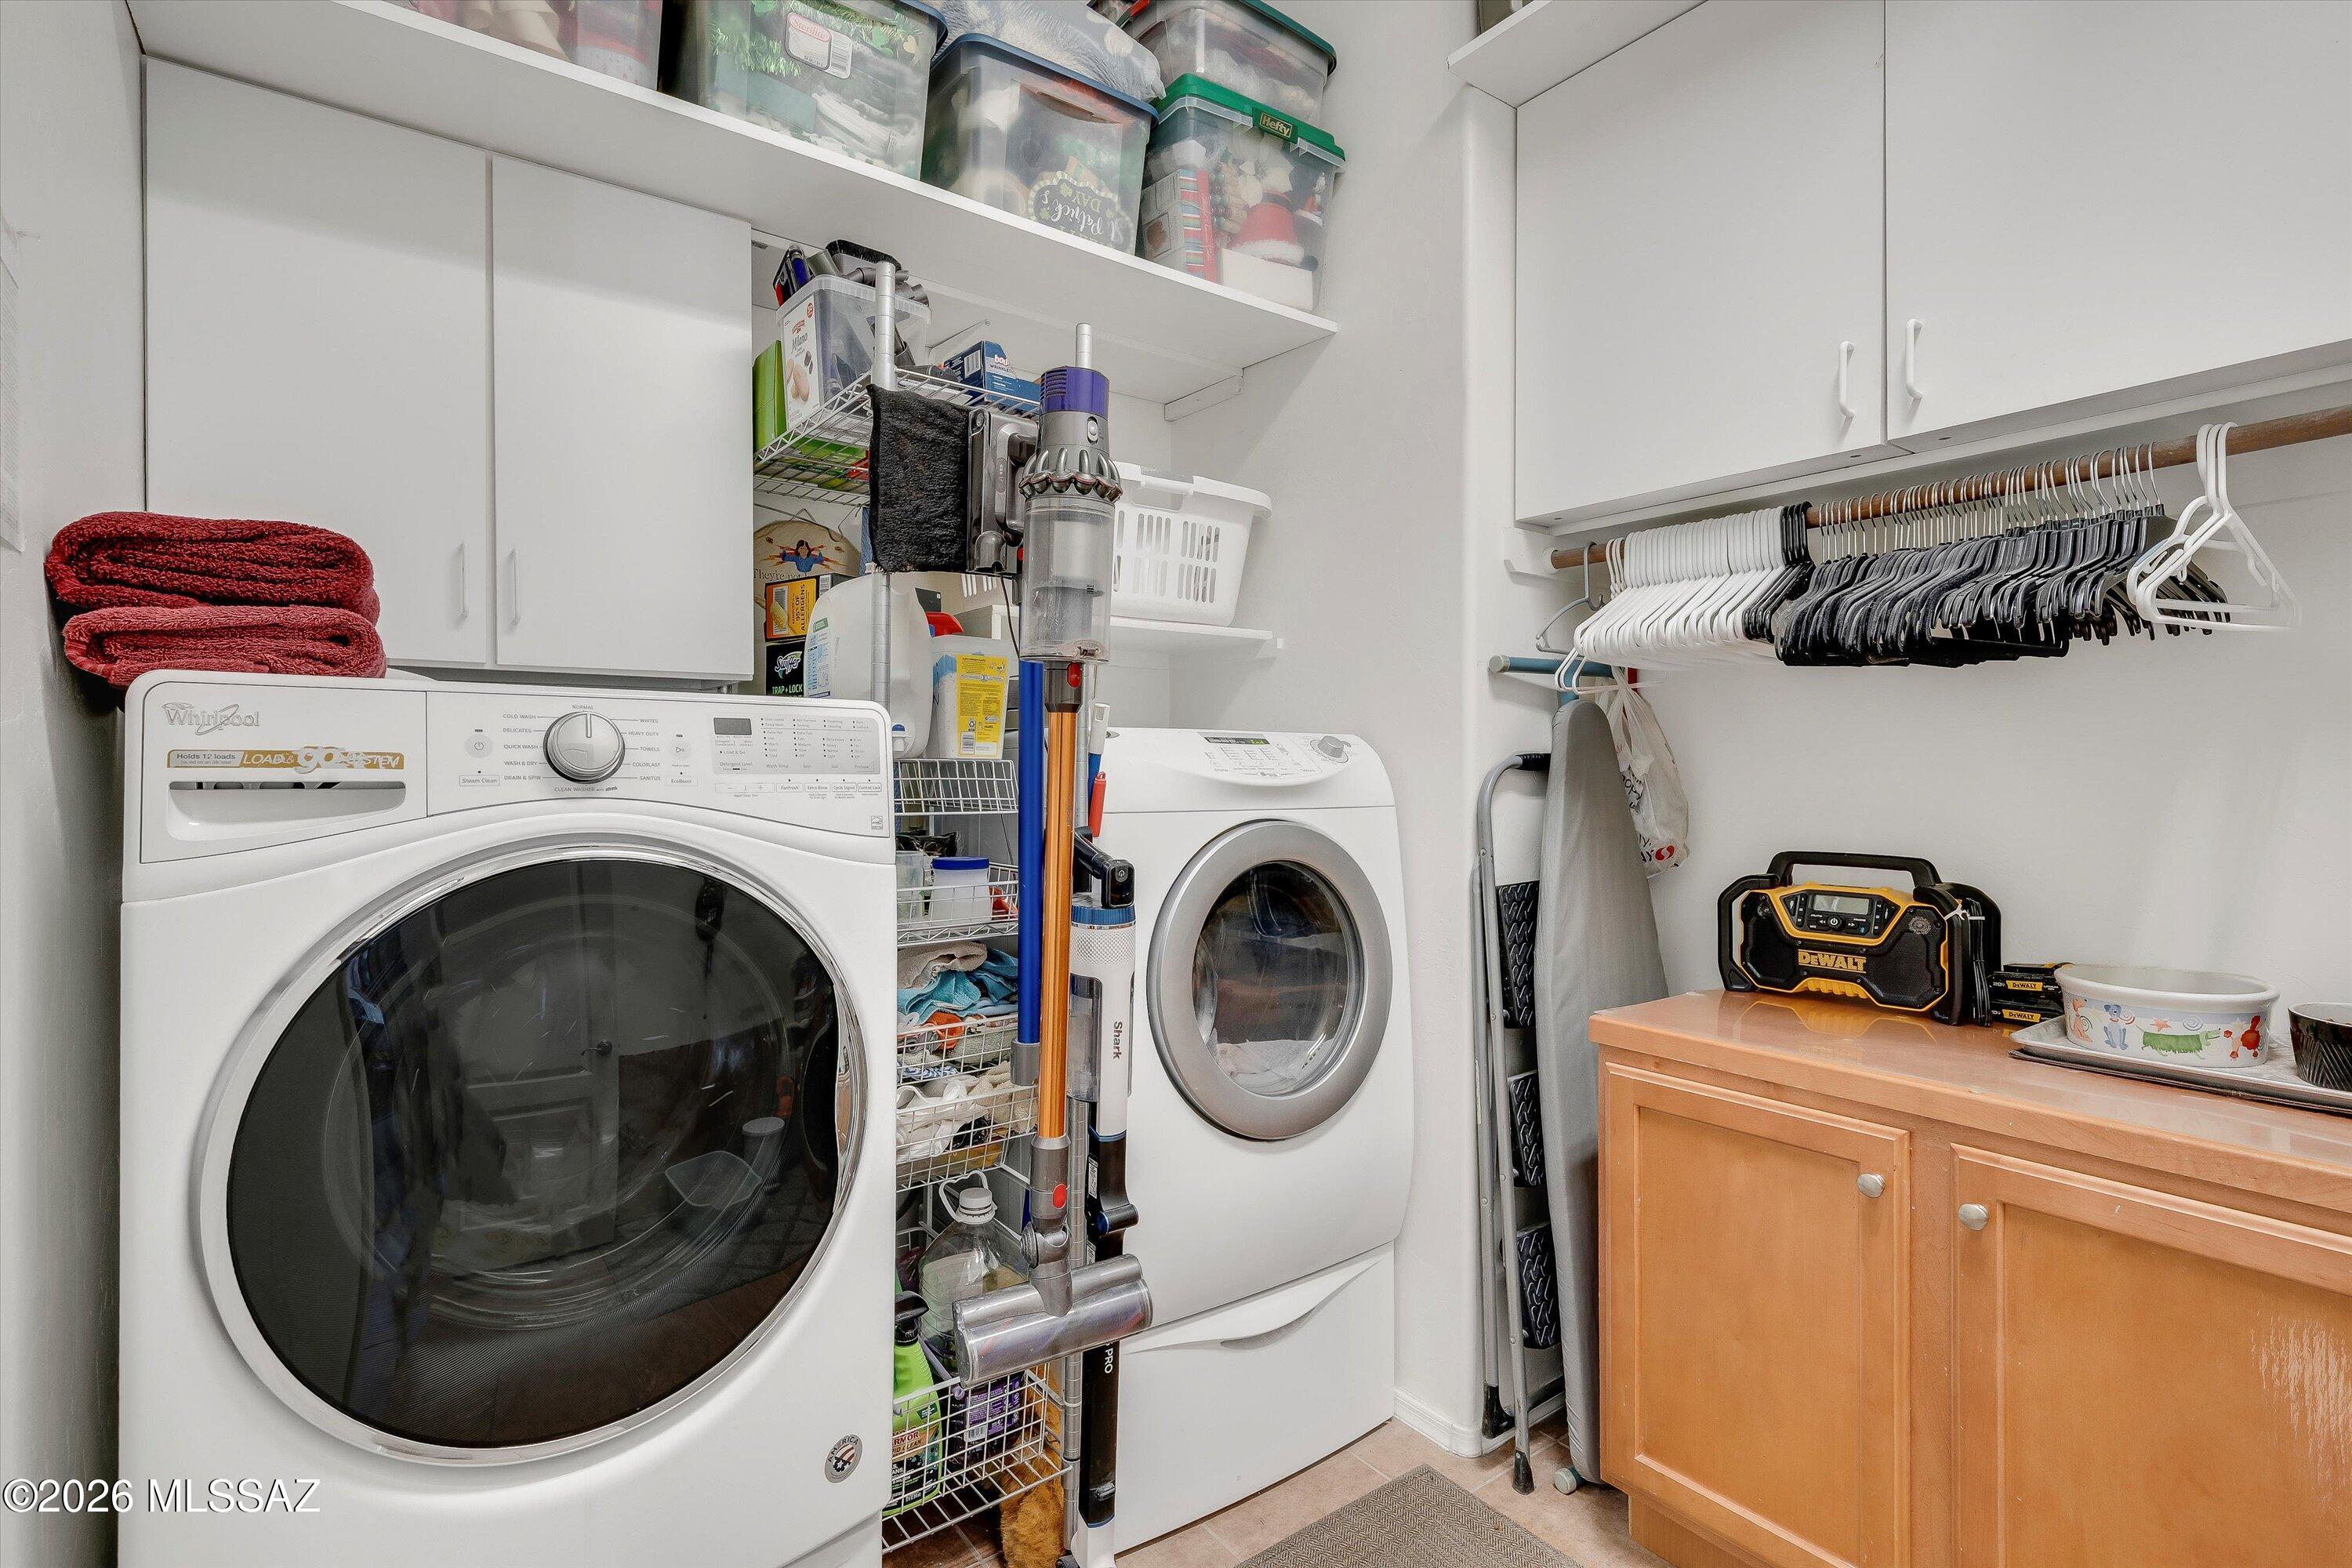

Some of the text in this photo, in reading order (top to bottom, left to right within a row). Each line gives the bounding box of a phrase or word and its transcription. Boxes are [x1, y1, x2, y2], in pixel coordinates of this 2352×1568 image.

[793, 17, 826, 39] Sterilite
[1261, 114, 1290, 136] Hefty
[1071, 190, 1102, 213] DAY
[791, 333, 808, 354] Milano
[995, 354, 1009, 366] bou
[795, 596, 800, 605] OF
[775, 655, 800, 674] Swiffer
[772, 685, 785, 695] TRAP
[789, 684, 803, 693] LOCK
[163, 705, 260, 732] Whirlpool
[1798, 950, 1866, 971] DEWALT
[1113, 1021, 1123, 1059] Shark
[1105, 1348, 1114, 1374] PRO
[828, 1436, 858, 1462] AMERICA
[892, 1432, 920, 1446] RMOR
